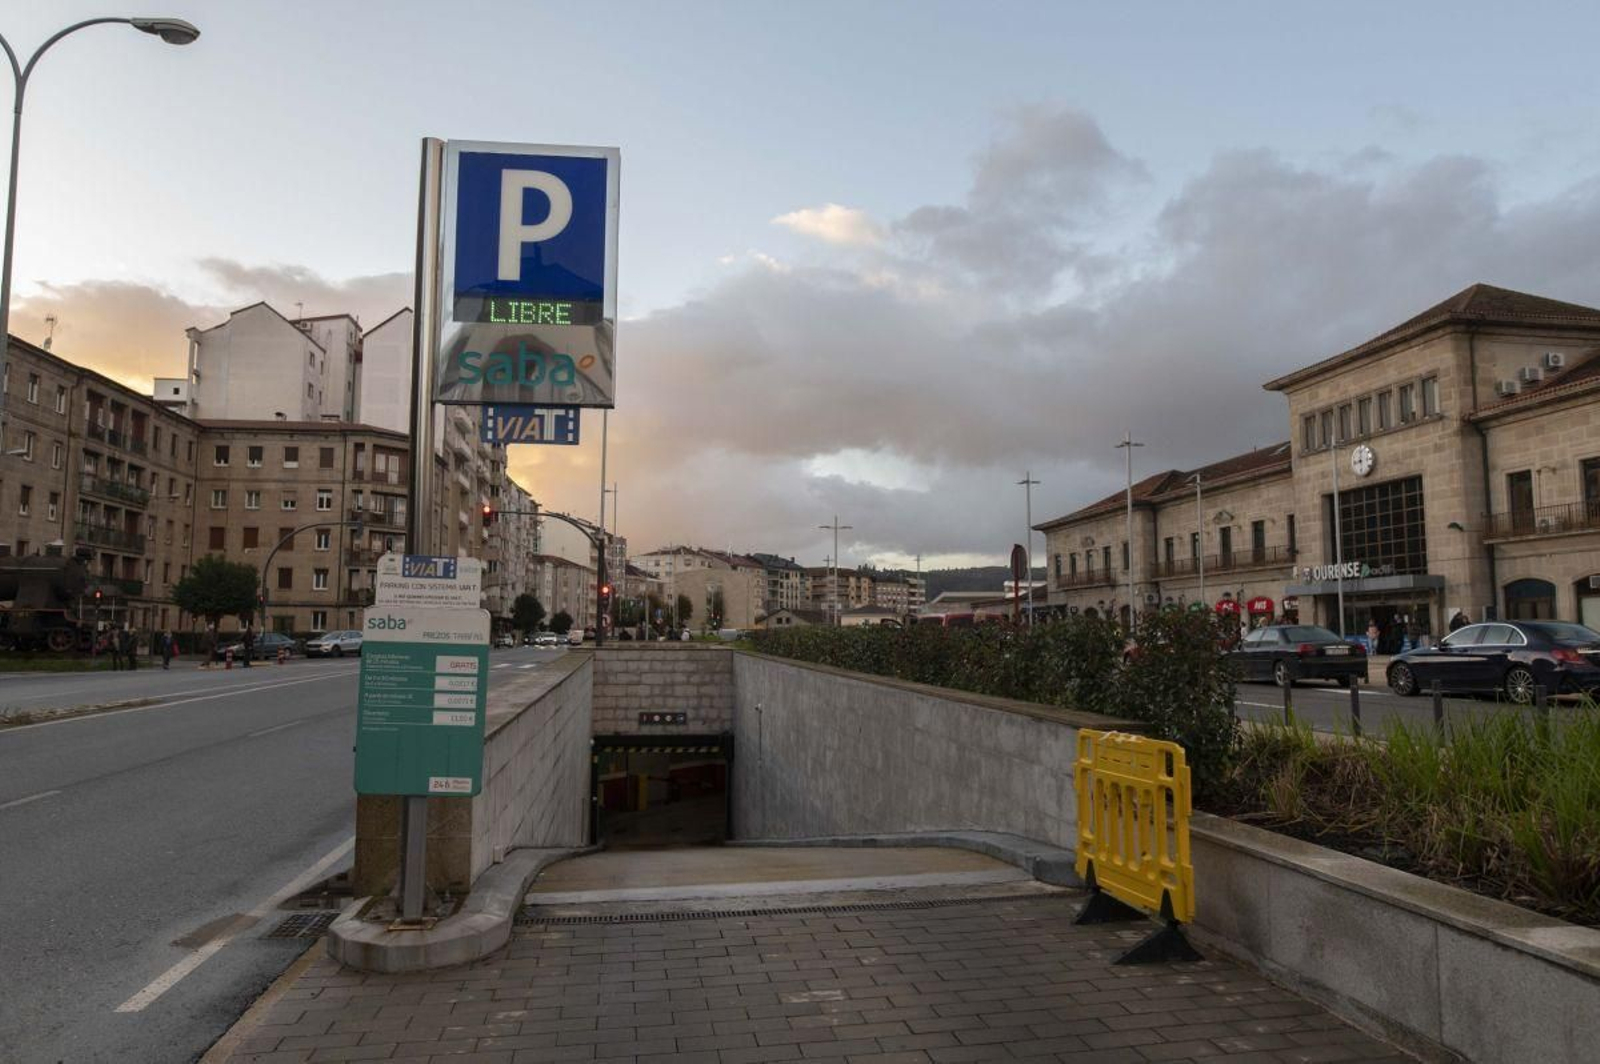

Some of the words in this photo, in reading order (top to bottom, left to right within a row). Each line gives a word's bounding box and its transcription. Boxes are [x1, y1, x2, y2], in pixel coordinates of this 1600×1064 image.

[497, 168, 573, 281] P
[490, 301, 572, 325] LIBRE
[457, 340, 576, 386] saba
[1313, 561, 1360, 581] OURENSE
[380, 582, 409, 590] PARKING
[368, 614, 406, 630] saba
